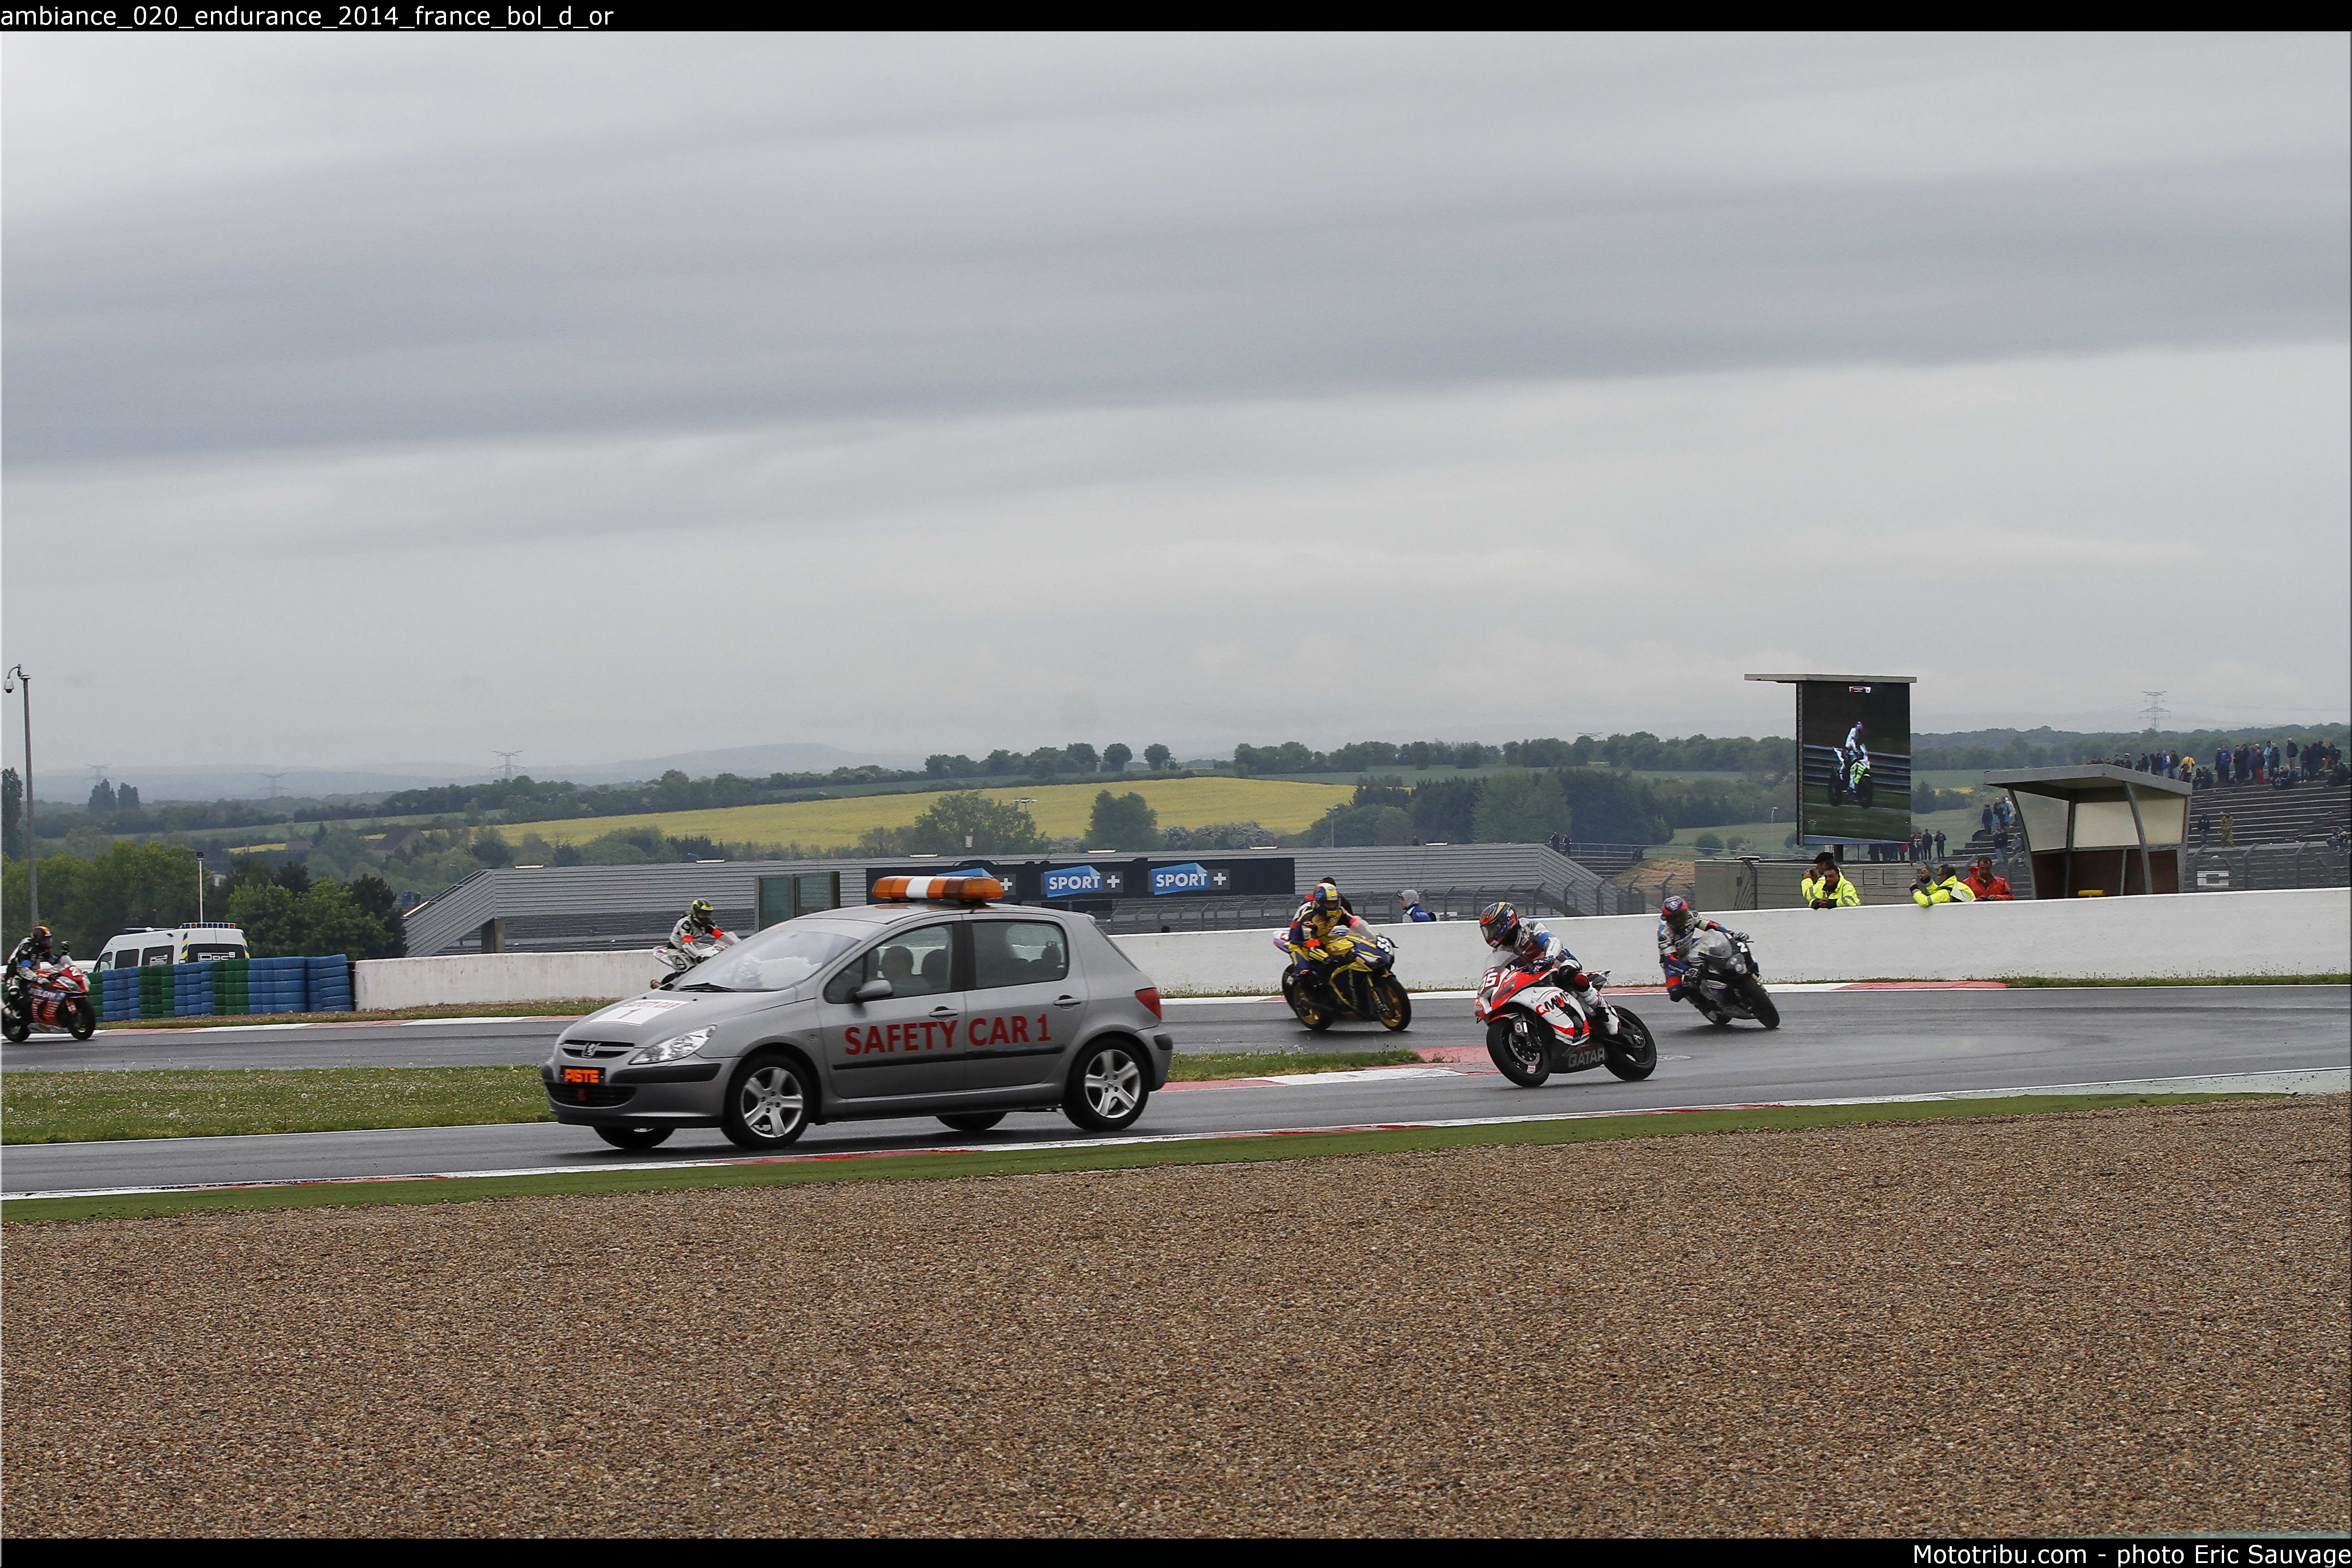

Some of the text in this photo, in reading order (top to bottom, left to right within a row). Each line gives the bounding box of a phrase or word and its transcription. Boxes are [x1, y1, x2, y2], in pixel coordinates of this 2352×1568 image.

[1049, 876, 1101, 890] SPORT
[1156, 873, 1207, 887] SPORT
[1377, 935, 1392, 953] 55
[845, 1014, 1052, 1056] SAFETY CAR 1
[1568, 1047, 1605, 1068] QATAR
[564, 1068, 599, 1083] PISTE
